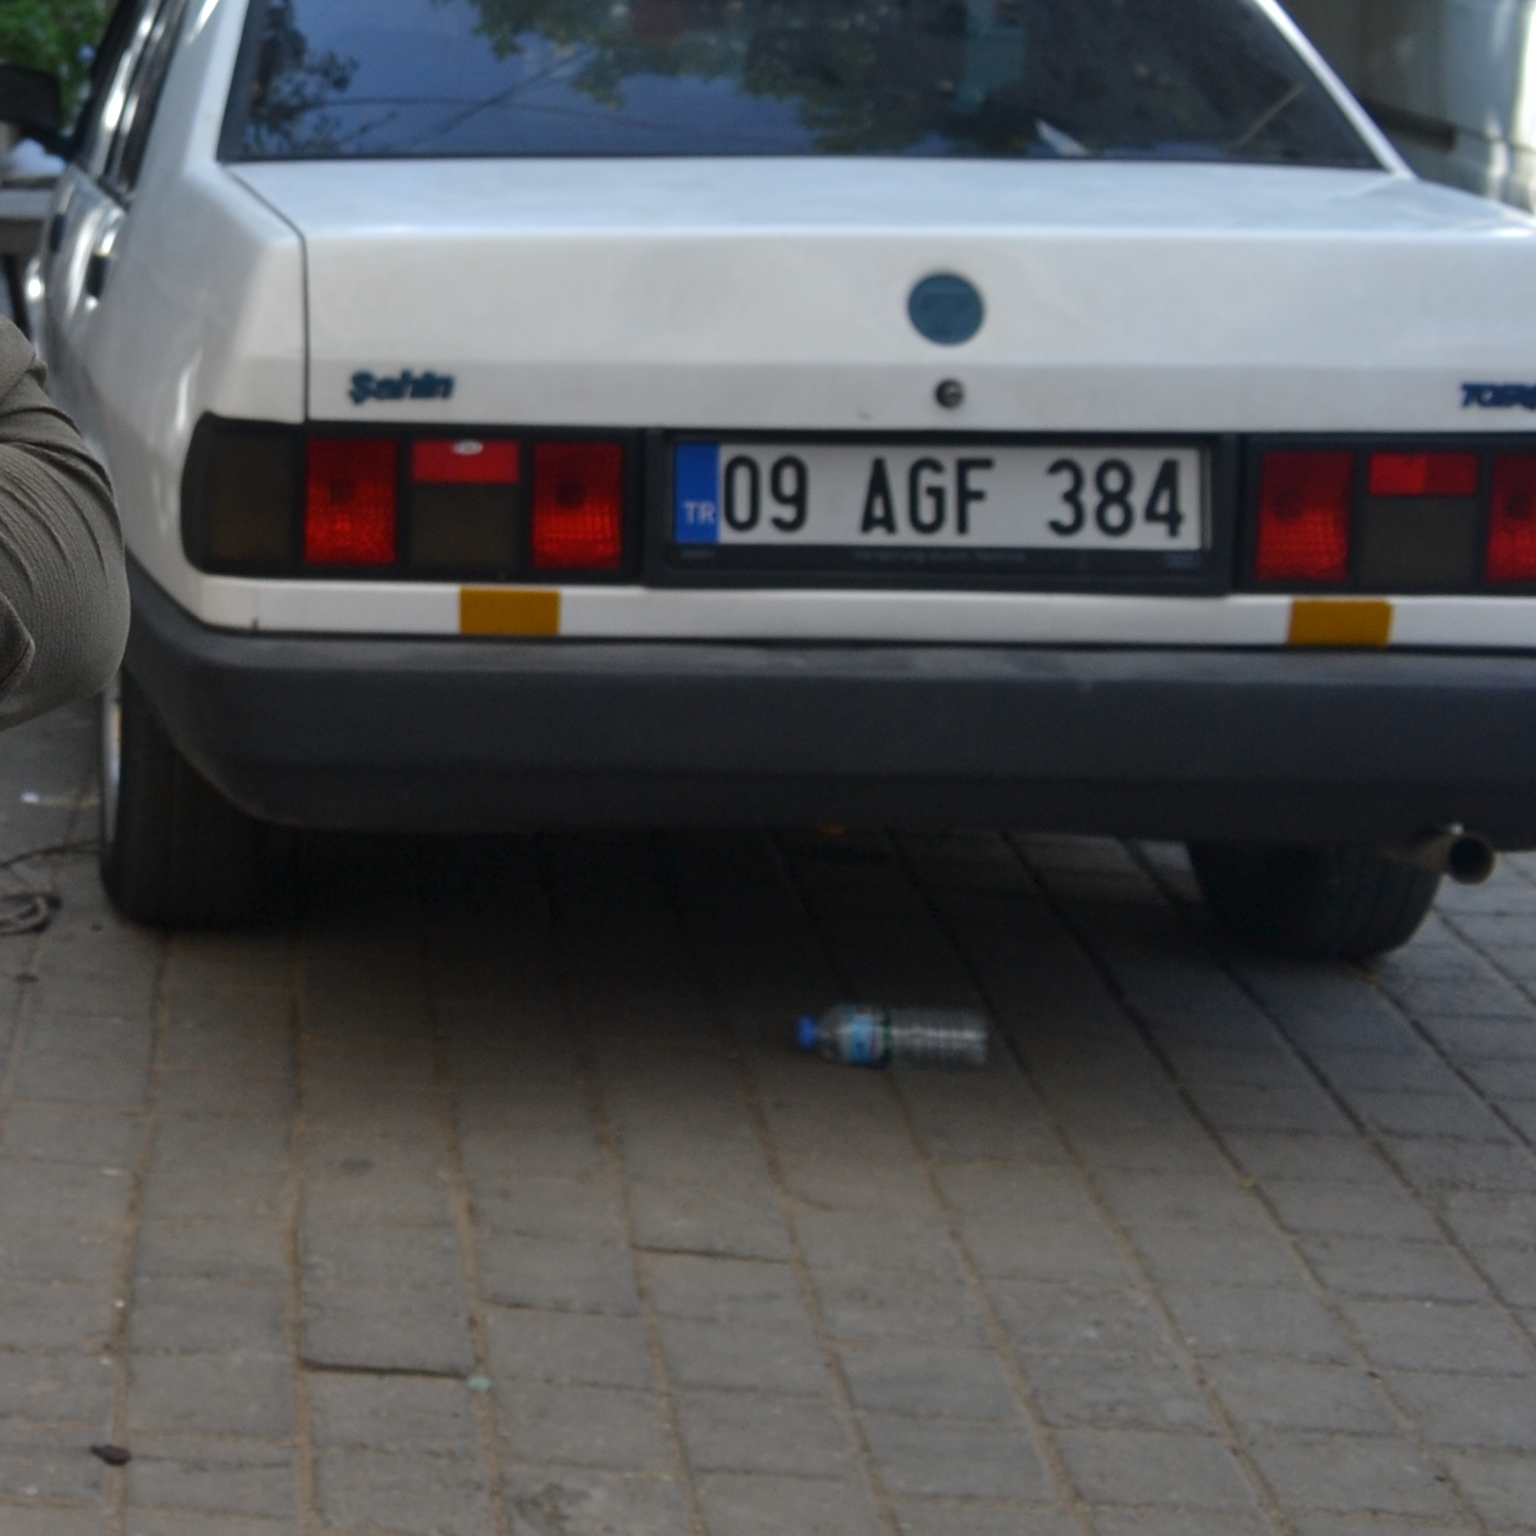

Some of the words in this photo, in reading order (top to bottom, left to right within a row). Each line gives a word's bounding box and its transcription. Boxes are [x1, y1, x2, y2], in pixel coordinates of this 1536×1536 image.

[684, 501, 716, 525] TR
[726, 456, 809, 533] 09
[861, 457, 995, 535] AGF
[1047, 458, 1184, 537] 384
